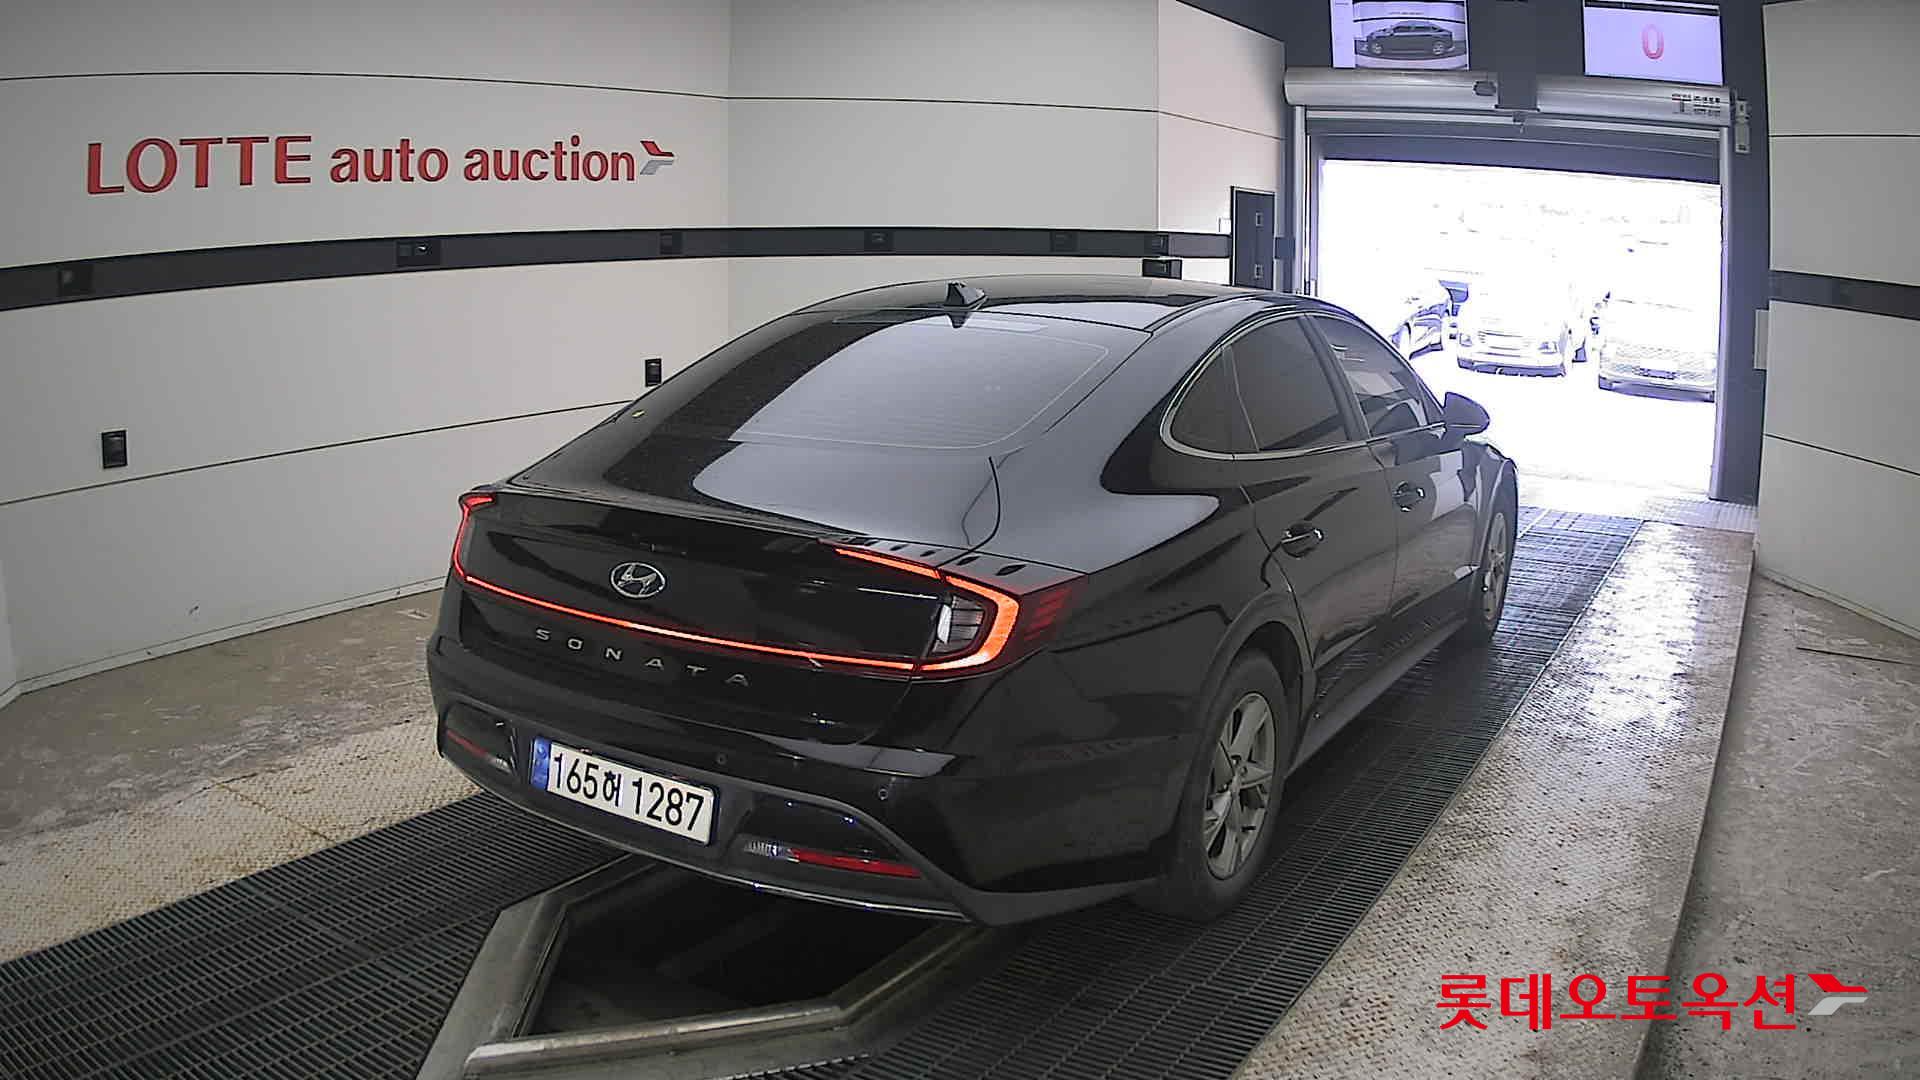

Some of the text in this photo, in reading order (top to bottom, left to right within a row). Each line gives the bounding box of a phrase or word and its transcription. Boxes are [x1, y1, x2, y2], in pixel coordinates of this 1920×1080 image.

[87, 134, 636, 195] LOTTE auto auction
[535, 627, 750, 687] SONATA
[553, 752, 705, 832] 165허 1287
